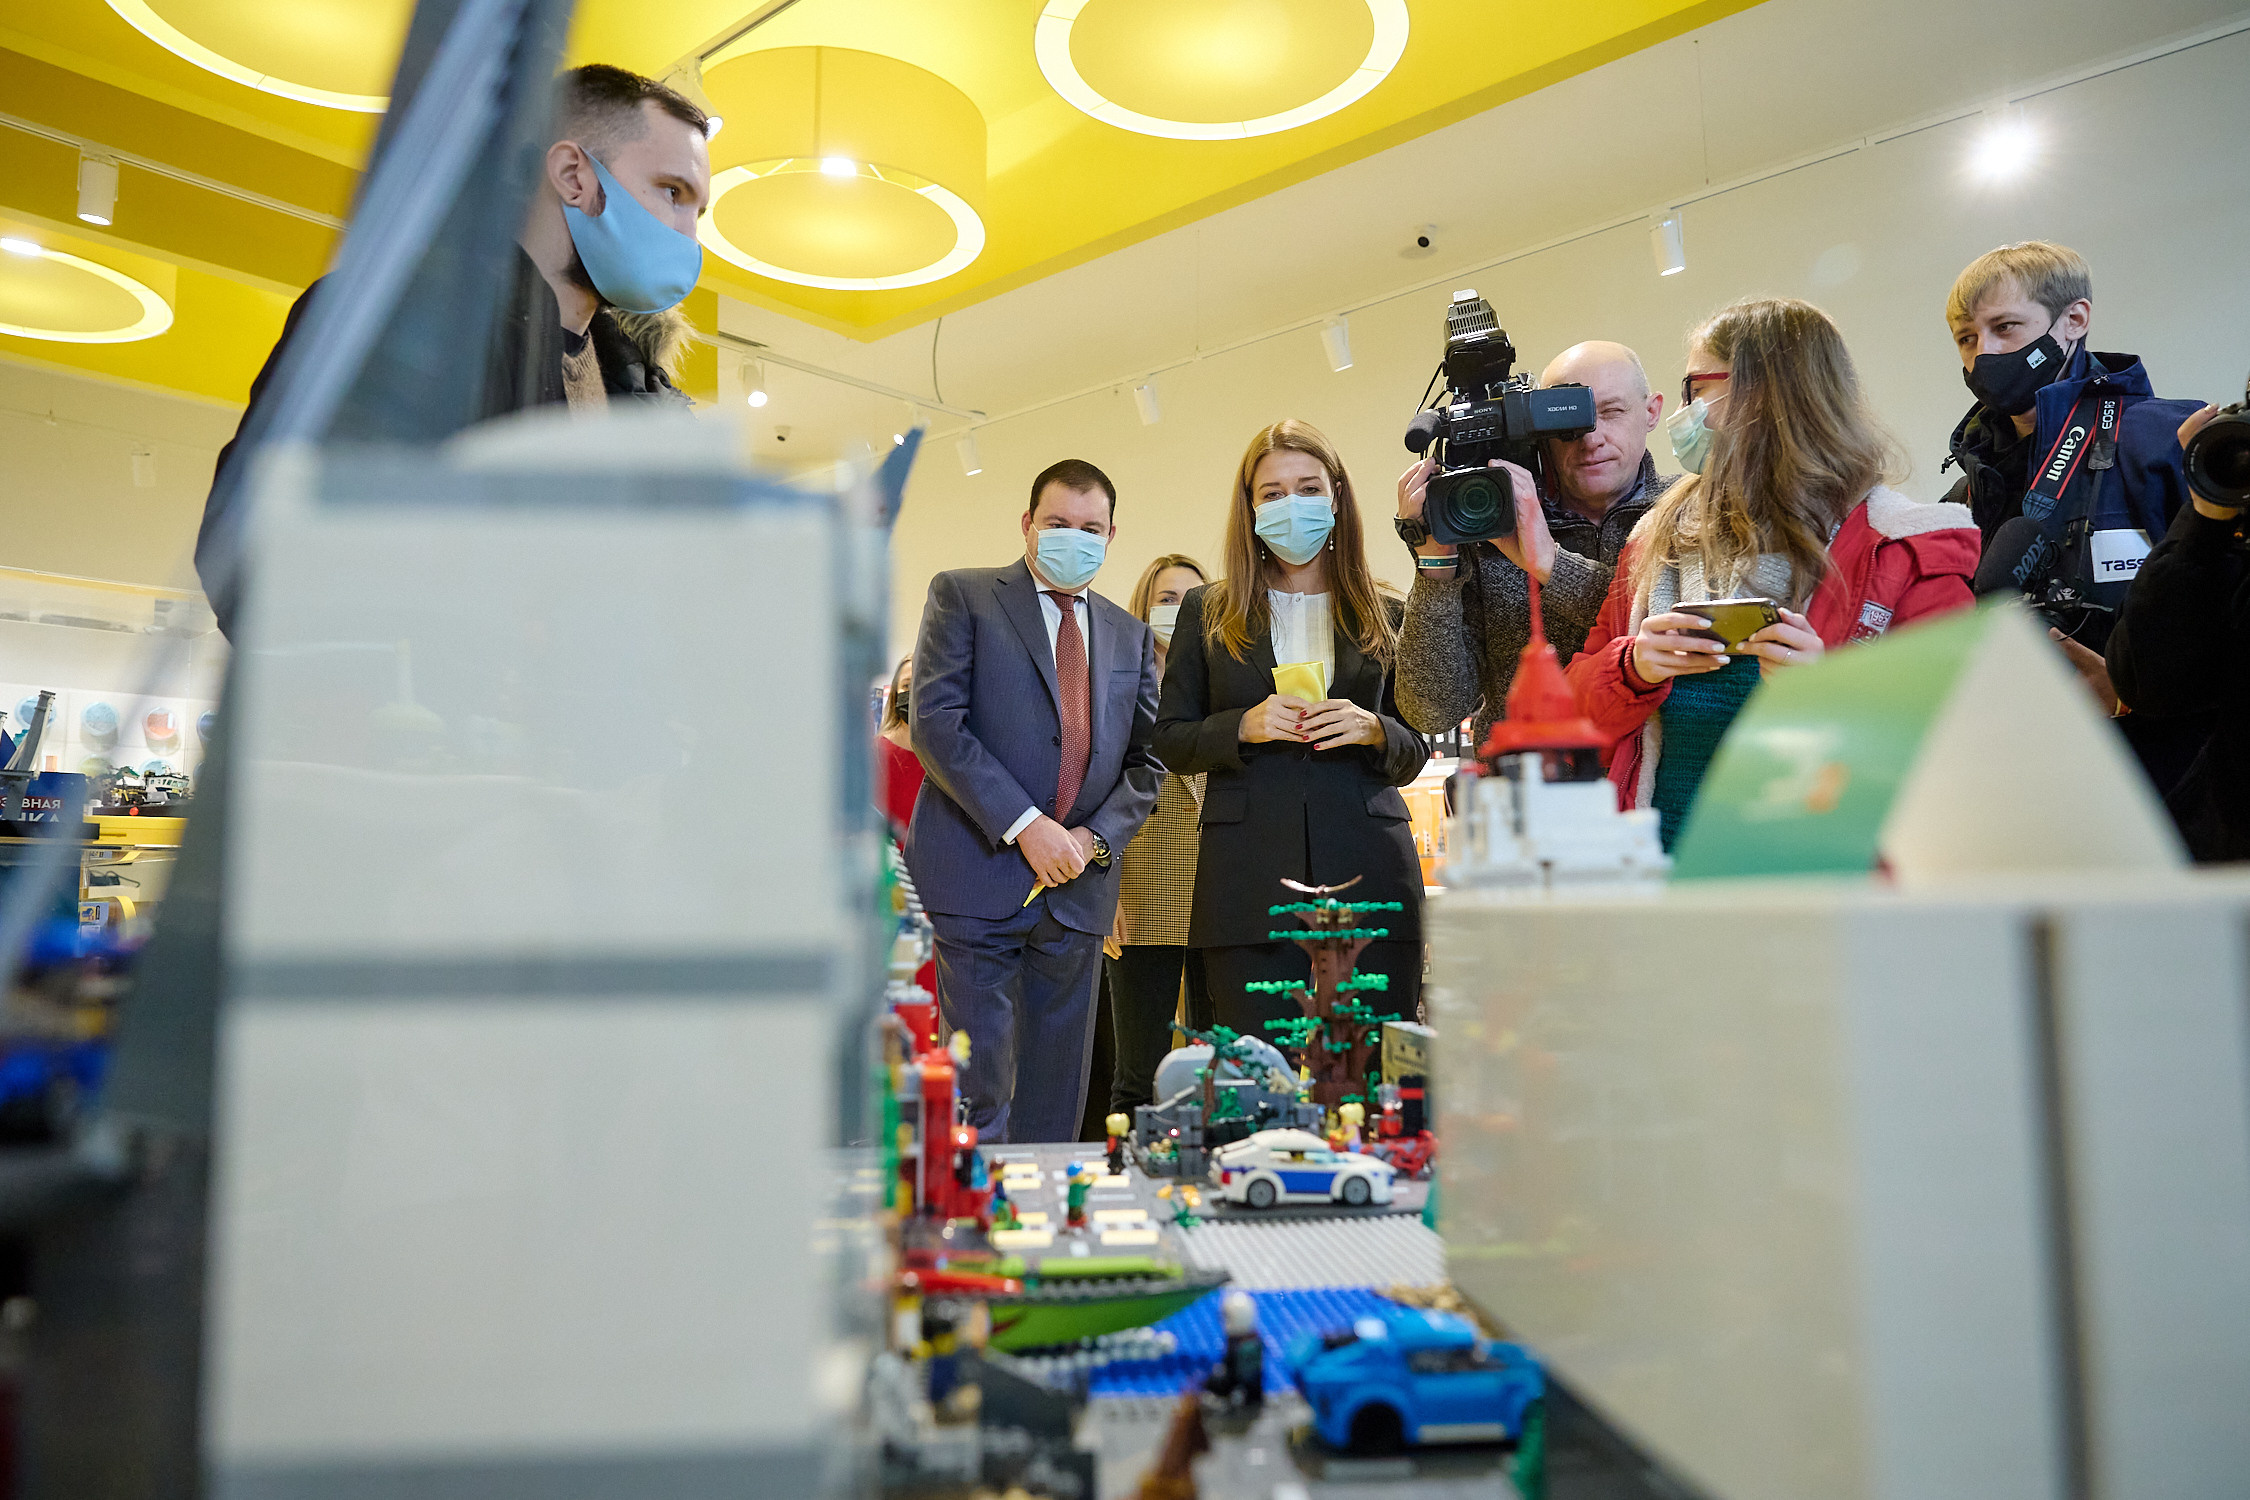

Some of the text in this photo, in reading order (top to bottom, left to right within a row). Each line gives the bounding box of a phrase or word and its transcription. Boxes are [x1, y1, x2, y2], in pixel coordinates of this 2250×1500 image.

[1474, 406, 1493, 414] SONY
[2102, 409, 2114, 429] EOS
[2046, 426, 2086, 482] Canon
